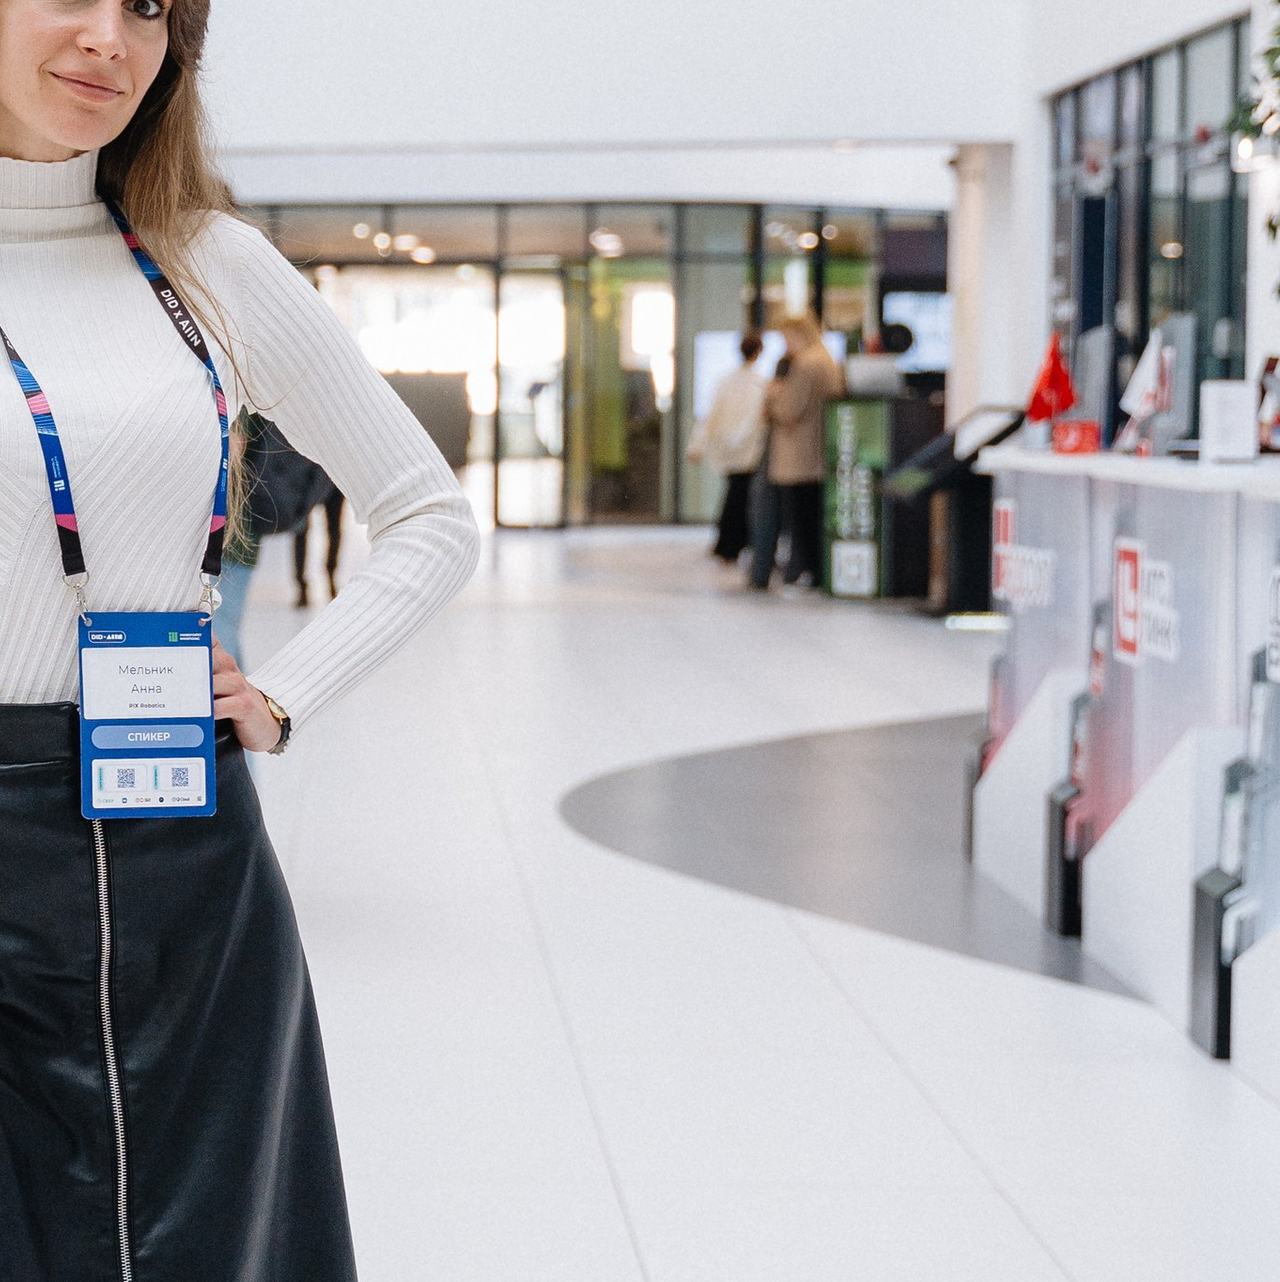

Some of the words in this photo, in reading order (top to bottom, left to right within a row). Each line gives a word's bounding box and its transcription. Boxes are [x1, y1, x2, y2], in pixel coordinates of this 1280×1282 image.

[160, 289, 179, 309] DID
[178, 319, 201, 347] AIIN
[118, 665, 174, 676] Мельник
[130, 683, 163, 694] Анна
[127, 731, 171, 743] СПИКЕР
